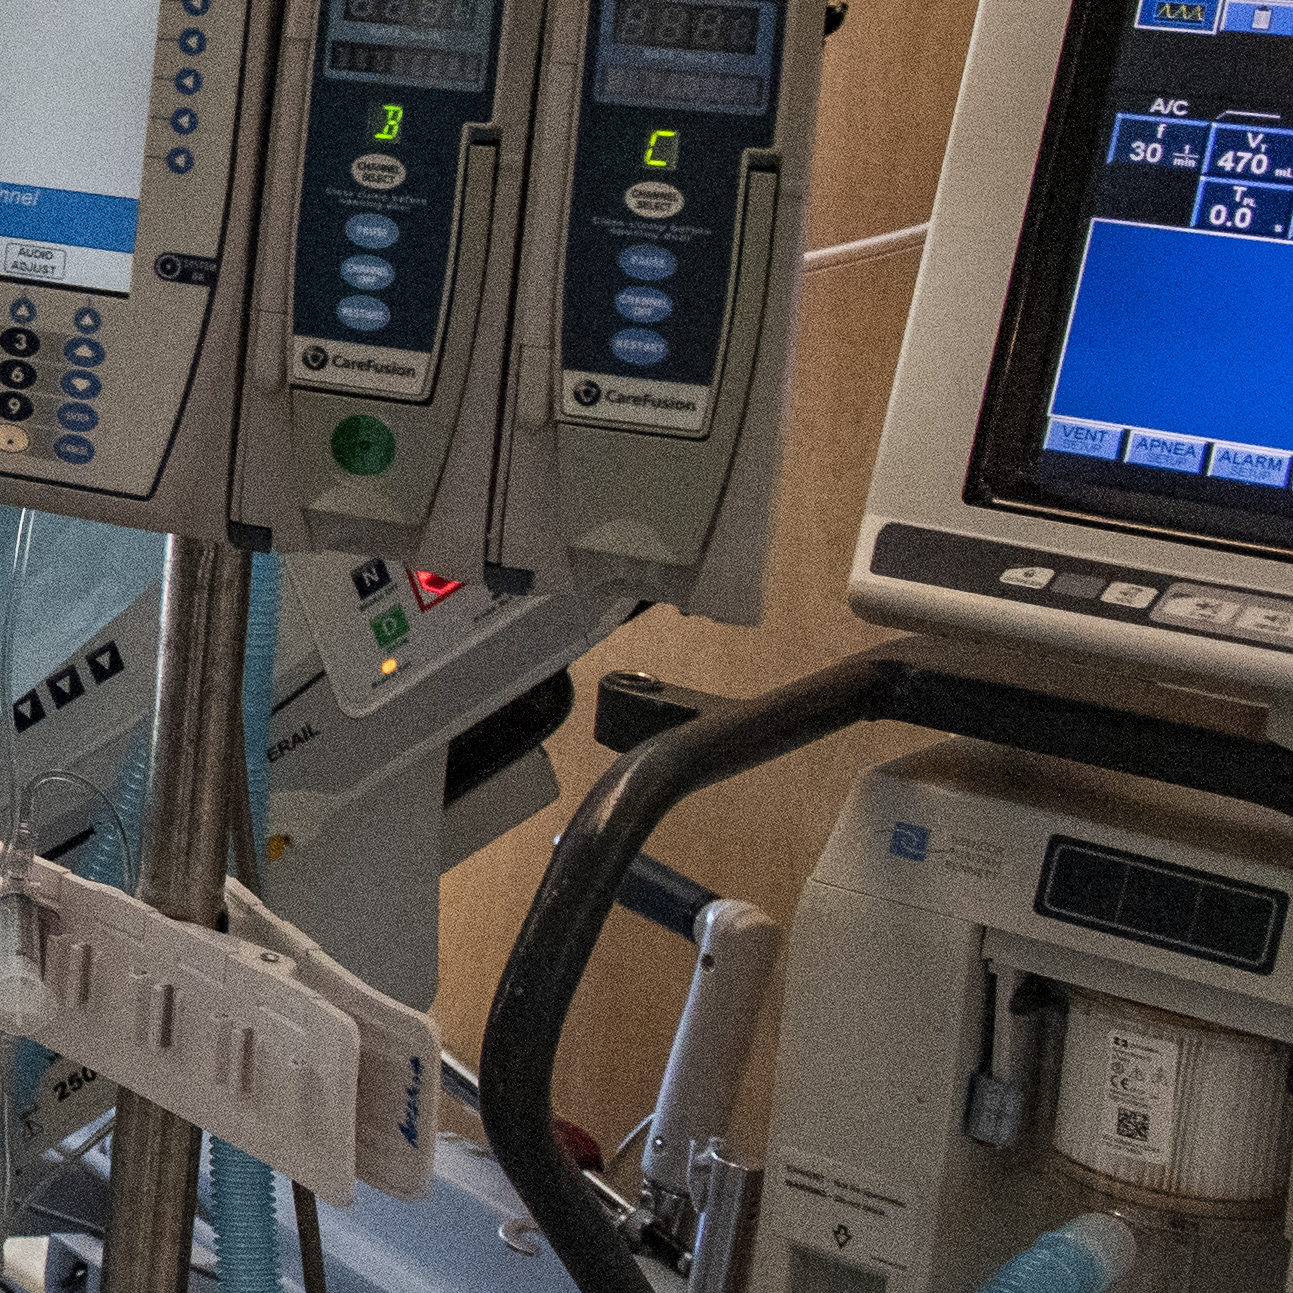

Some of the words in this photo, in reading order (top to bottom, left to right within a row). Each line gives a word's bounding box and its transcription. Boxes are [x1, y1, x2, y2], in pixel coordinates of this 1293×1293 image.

[1149, 97, 1189, 116] A/C
[374, 104, 403, 140] B
[645, 130, 676, 166] C
[1129, 140, 1162, 163] 30
[1217, 151, 1268, 175] 470
[1209, 204, 1252, 229] 0.0
[18, 246, 54, 261] AUDIO
[12, 260, 57, 276] ADJUST
[15, 333, 28, 349] 3
[12, 366, 24, 382] 6
[332, 354, 417, 379] CareFusion
[9, 398, 21, 414] 9
[605, 388, 696, 412] CareFusion
[1062, 424, 1108, 443] VENT
[1135, 437, 1197, 458] APNEA
[1219, 450, 1283, 472] ALARM
[362, 567, 379, 588] N
[381, 617, 398, 636] D
[266, 721, 321, 764] ERAIL
